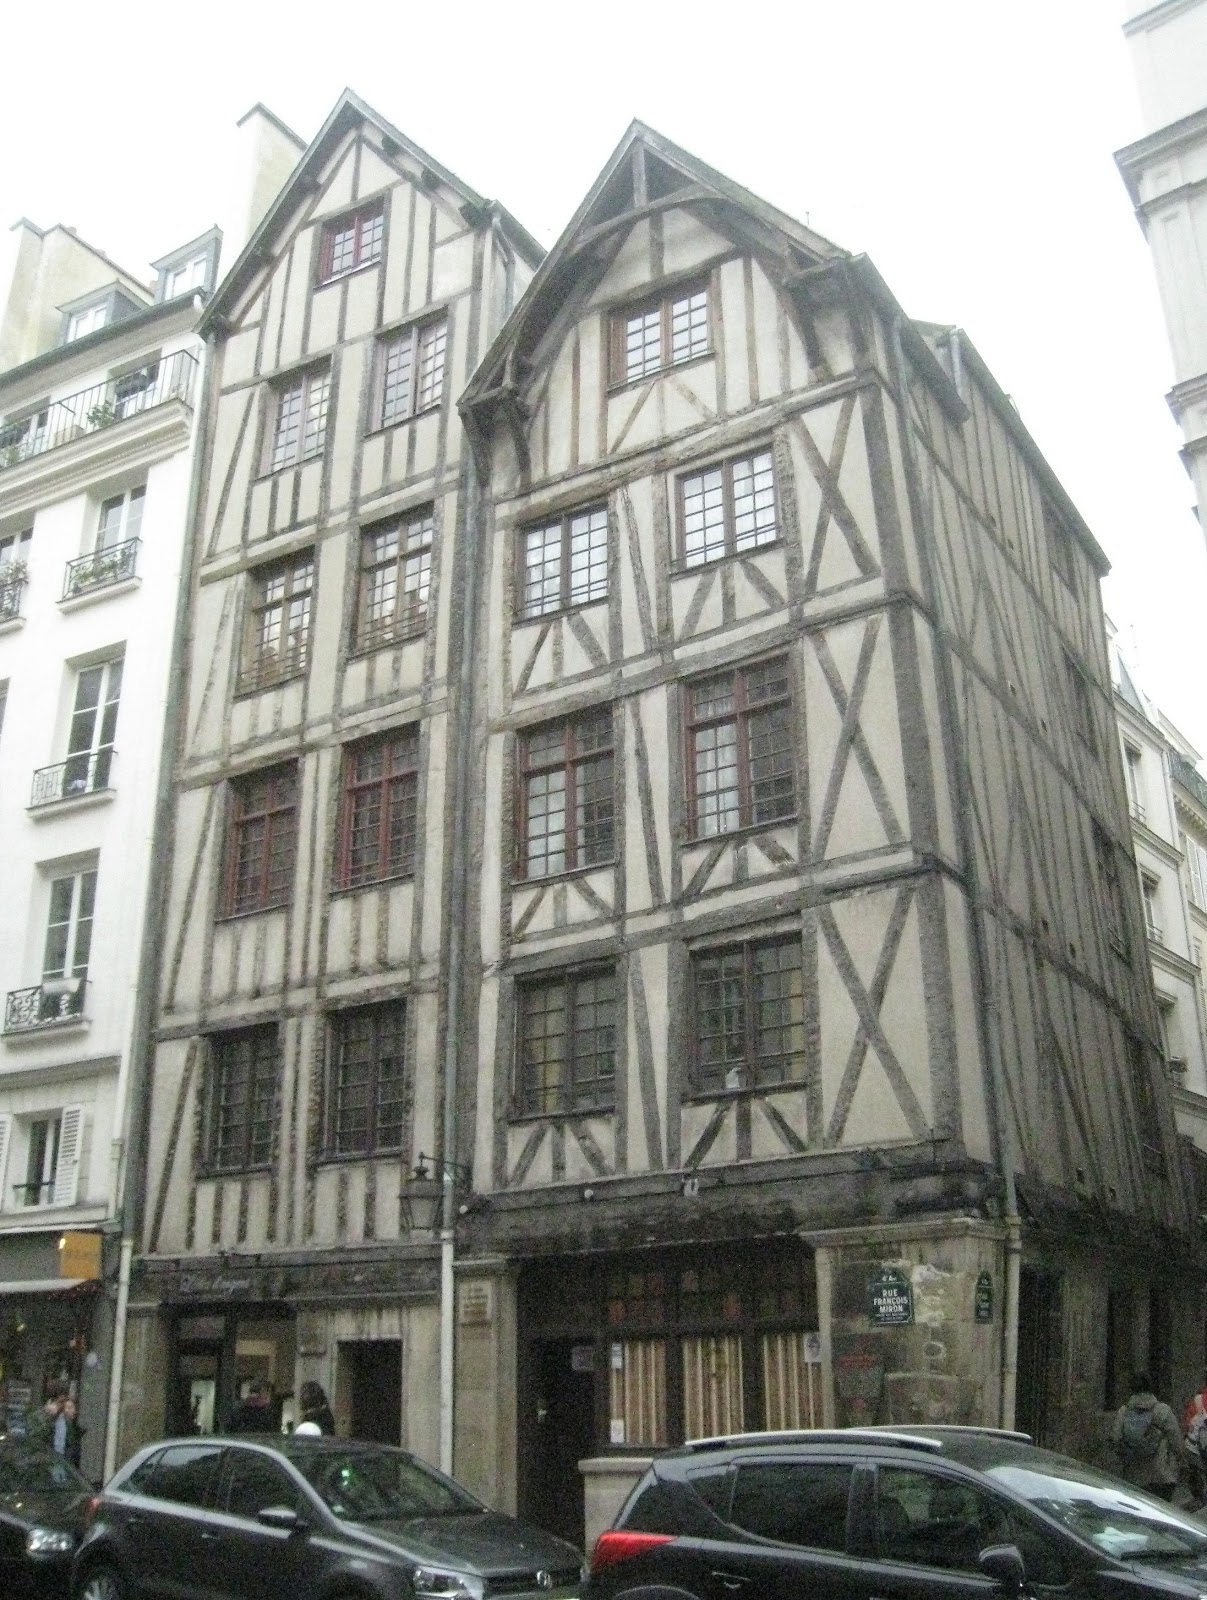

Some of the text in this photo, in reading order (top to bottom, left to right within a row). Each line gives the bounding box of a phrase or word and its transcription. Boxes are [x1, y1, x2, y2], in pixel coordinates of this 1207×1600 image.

[882, 1289, 898, 1297] RUE
[873, 1296, 908, 1305] FRANÇOIS
[879, 1305, 903, 1313] MIRON
